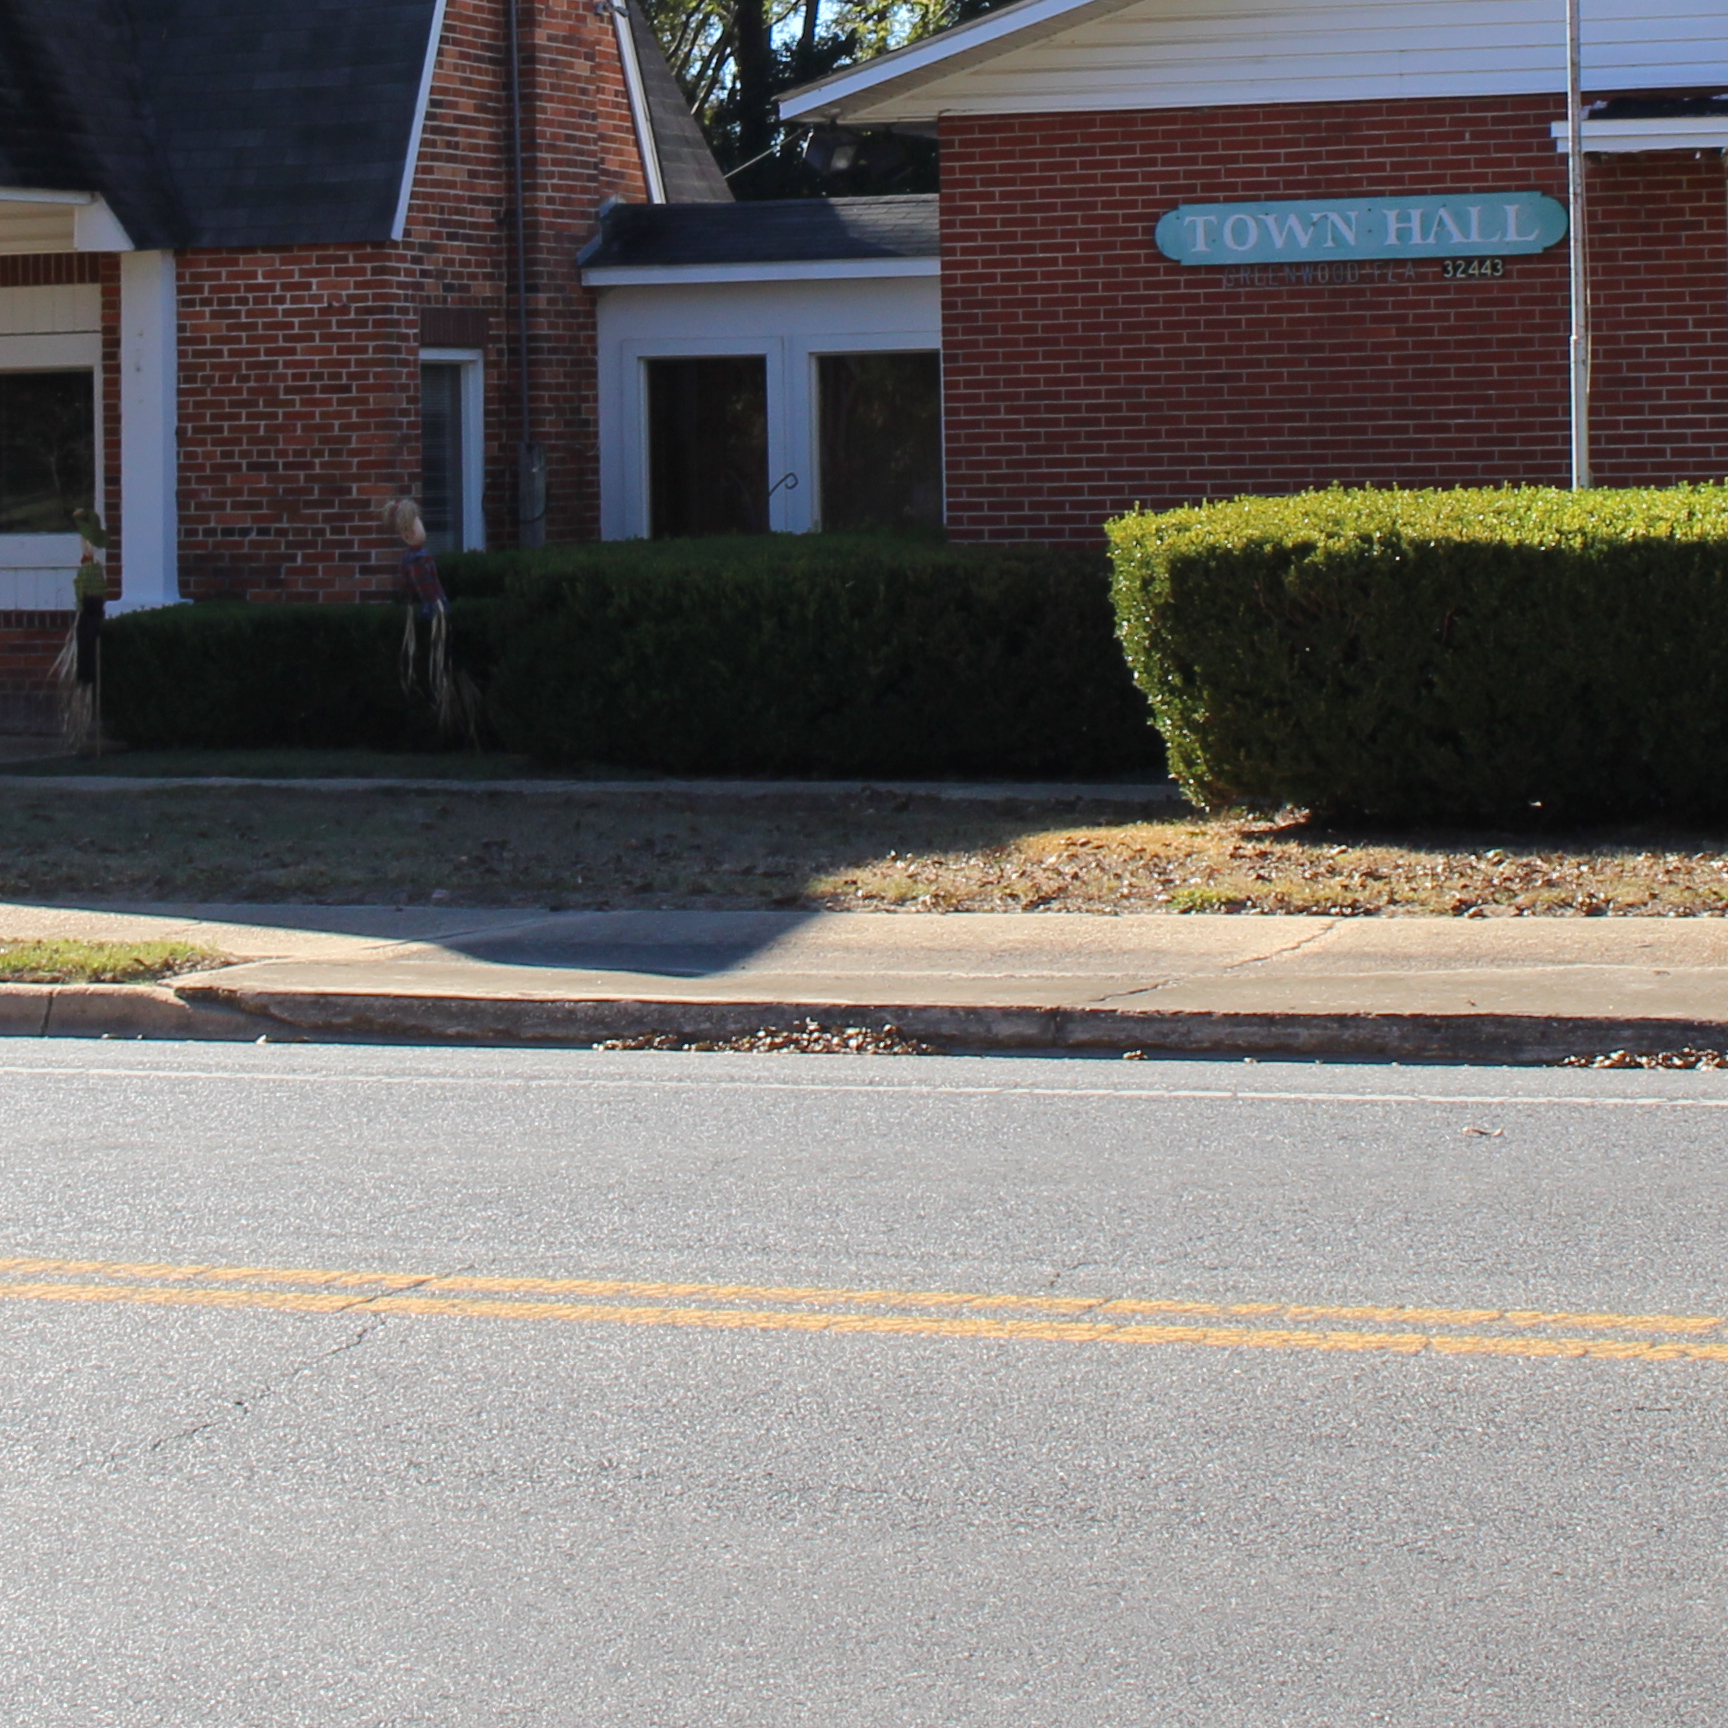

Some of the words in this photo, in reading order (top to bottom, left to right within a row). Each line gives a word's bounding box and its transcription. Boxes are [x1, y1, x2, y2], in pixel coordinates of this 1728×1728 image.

[1183, 210, 1360, 253] TOWN
[1383, 204, 1540, 246] HALL
[1224, 262, 1360, 287] GREENWOOD
[1442, 258, 1505, 279] 32443
